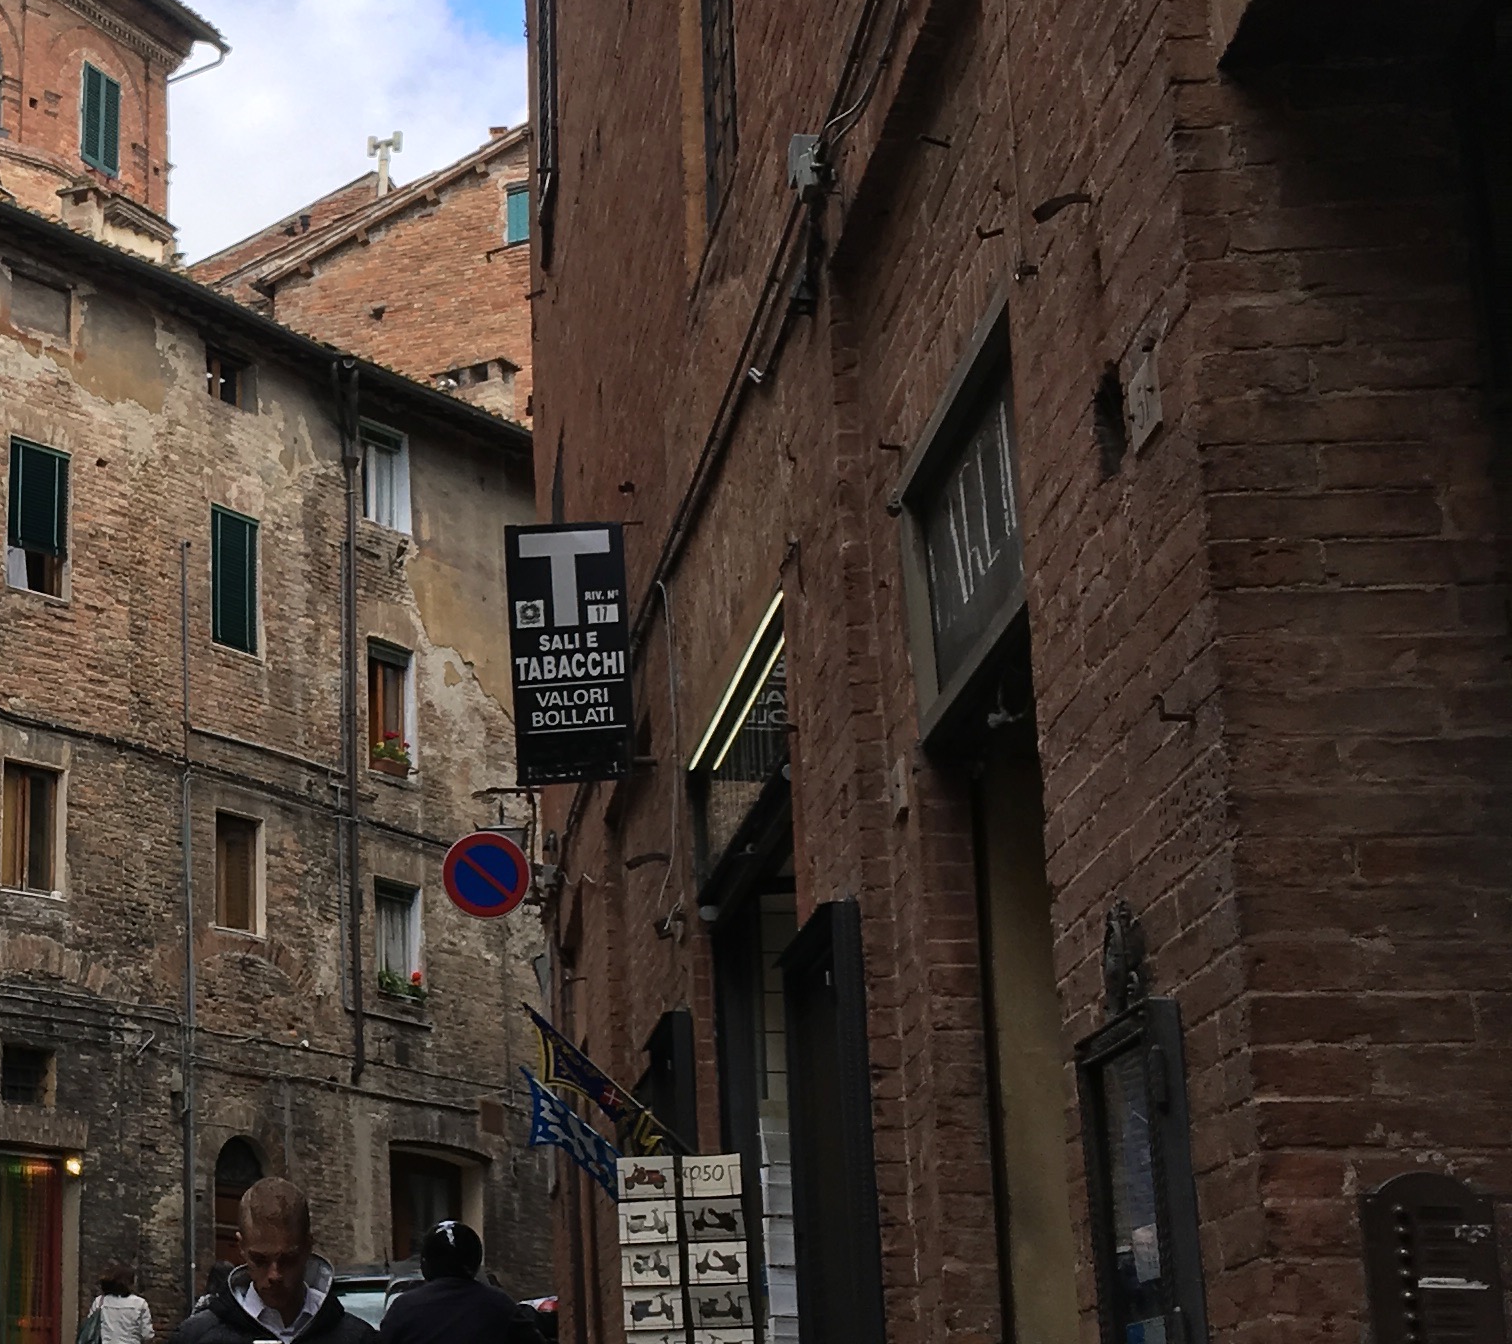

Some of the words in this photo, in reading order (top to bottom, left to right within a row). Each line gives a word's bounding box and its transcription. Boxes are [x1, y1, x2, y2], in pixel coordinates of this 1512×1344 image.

[518, 529, 611, 627] T
[584, 590, 604, 601] RIV.
[595, 605, 608, 622] 17
[539, 632, 580, 652] SALI
[586, 630, 598, 647] E
[516, 650, 625, 681] TABACCHI
[535, 687, 609, 707] VALORI
[532, 706, 615, 727] BOLLATI
